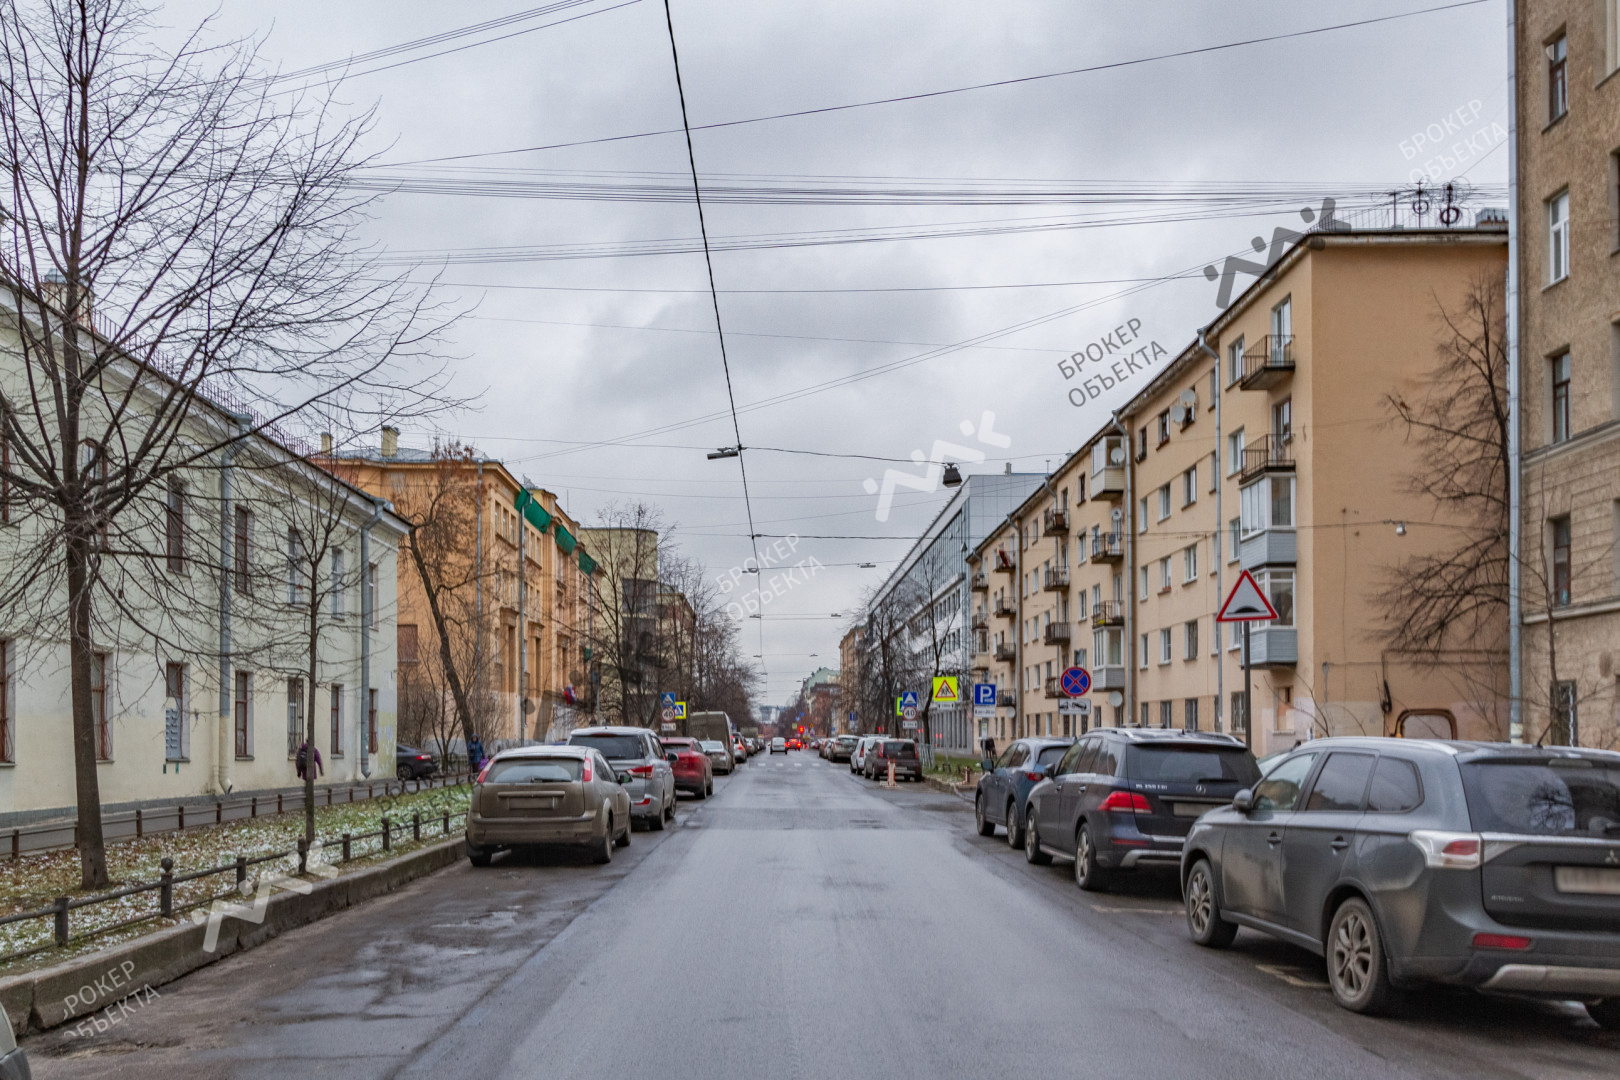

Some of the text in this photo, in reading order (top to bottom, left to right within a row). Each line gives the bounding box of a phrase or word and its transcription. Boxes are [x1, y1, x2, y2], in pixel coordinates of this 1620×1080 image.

[980, 685, 992, 703] P
[664, 710, 673, 718] 40
[905, 709, 915, 717] 40
